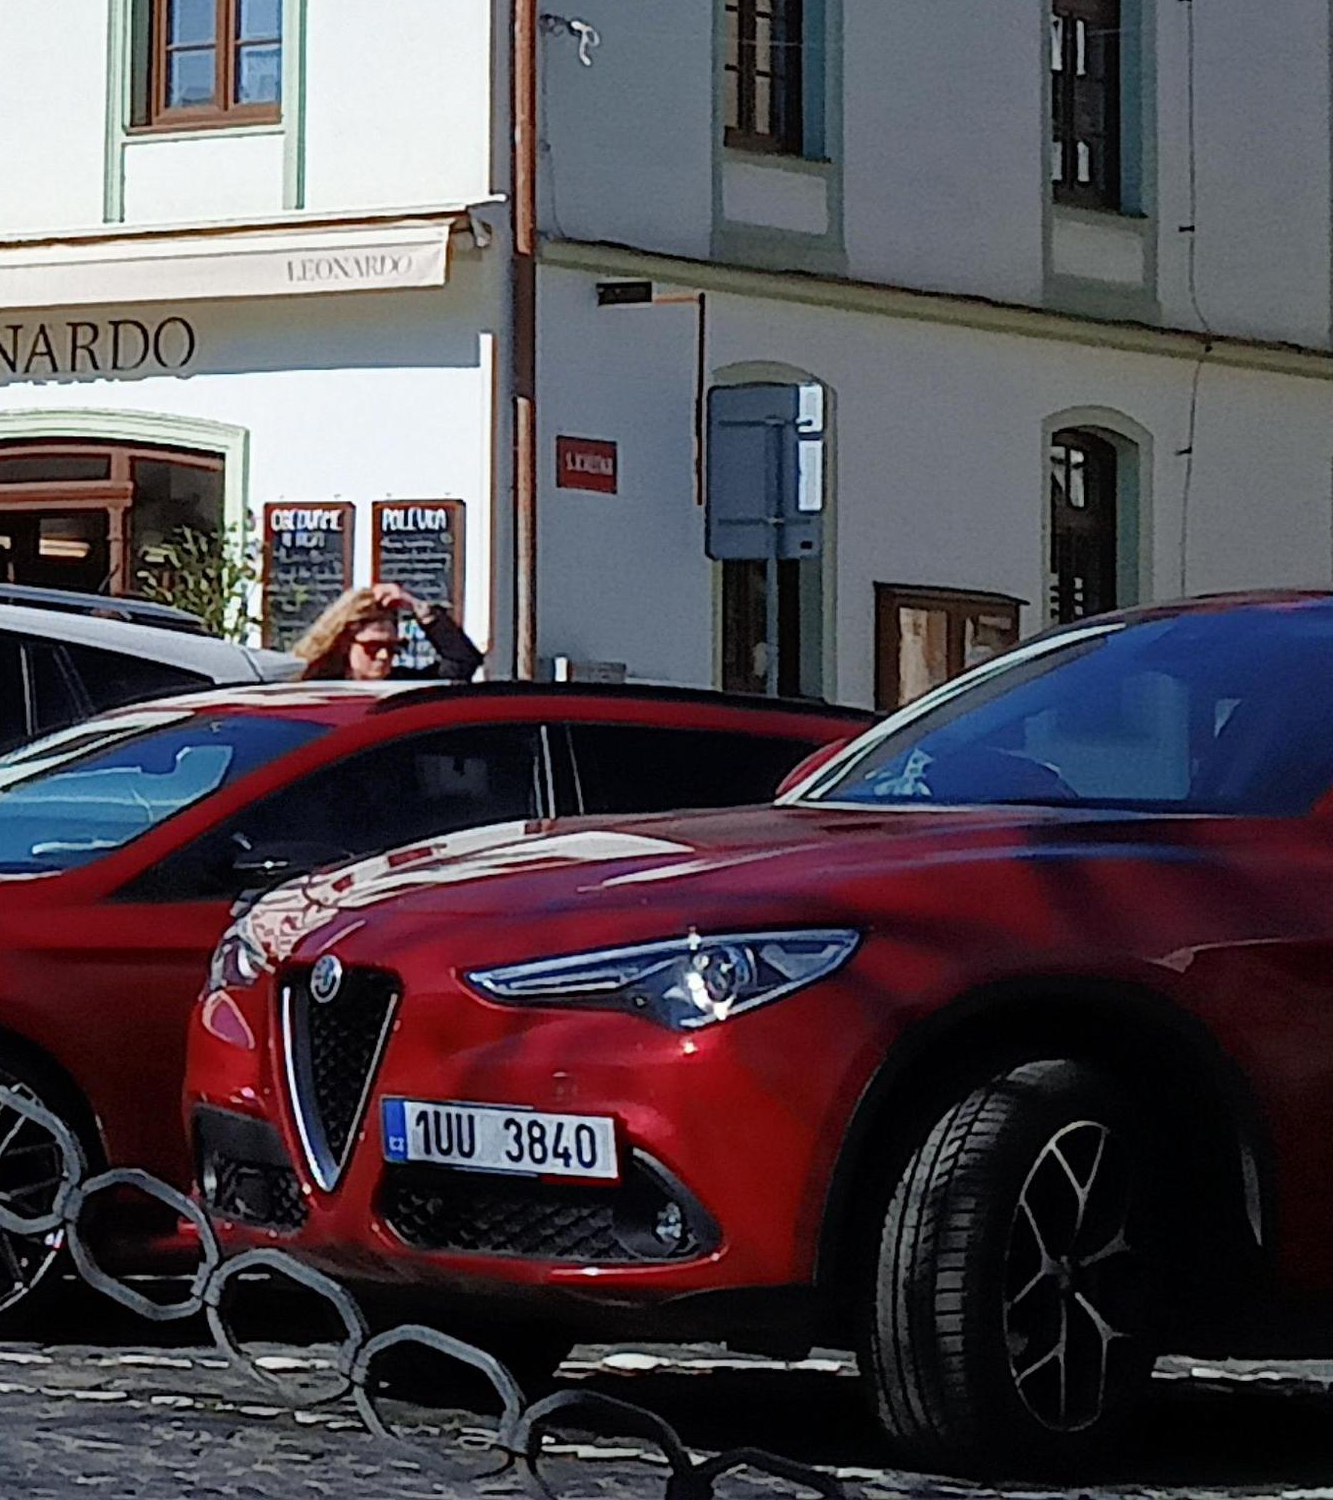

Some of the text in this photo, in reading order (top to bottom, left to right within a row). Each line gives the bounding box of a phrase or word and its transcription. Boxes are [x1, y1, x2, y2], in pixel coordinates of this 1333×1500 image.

[287, 255, 412, 282] LEONARDO
[415, 1110, 597, 1169] 1UU 3840
